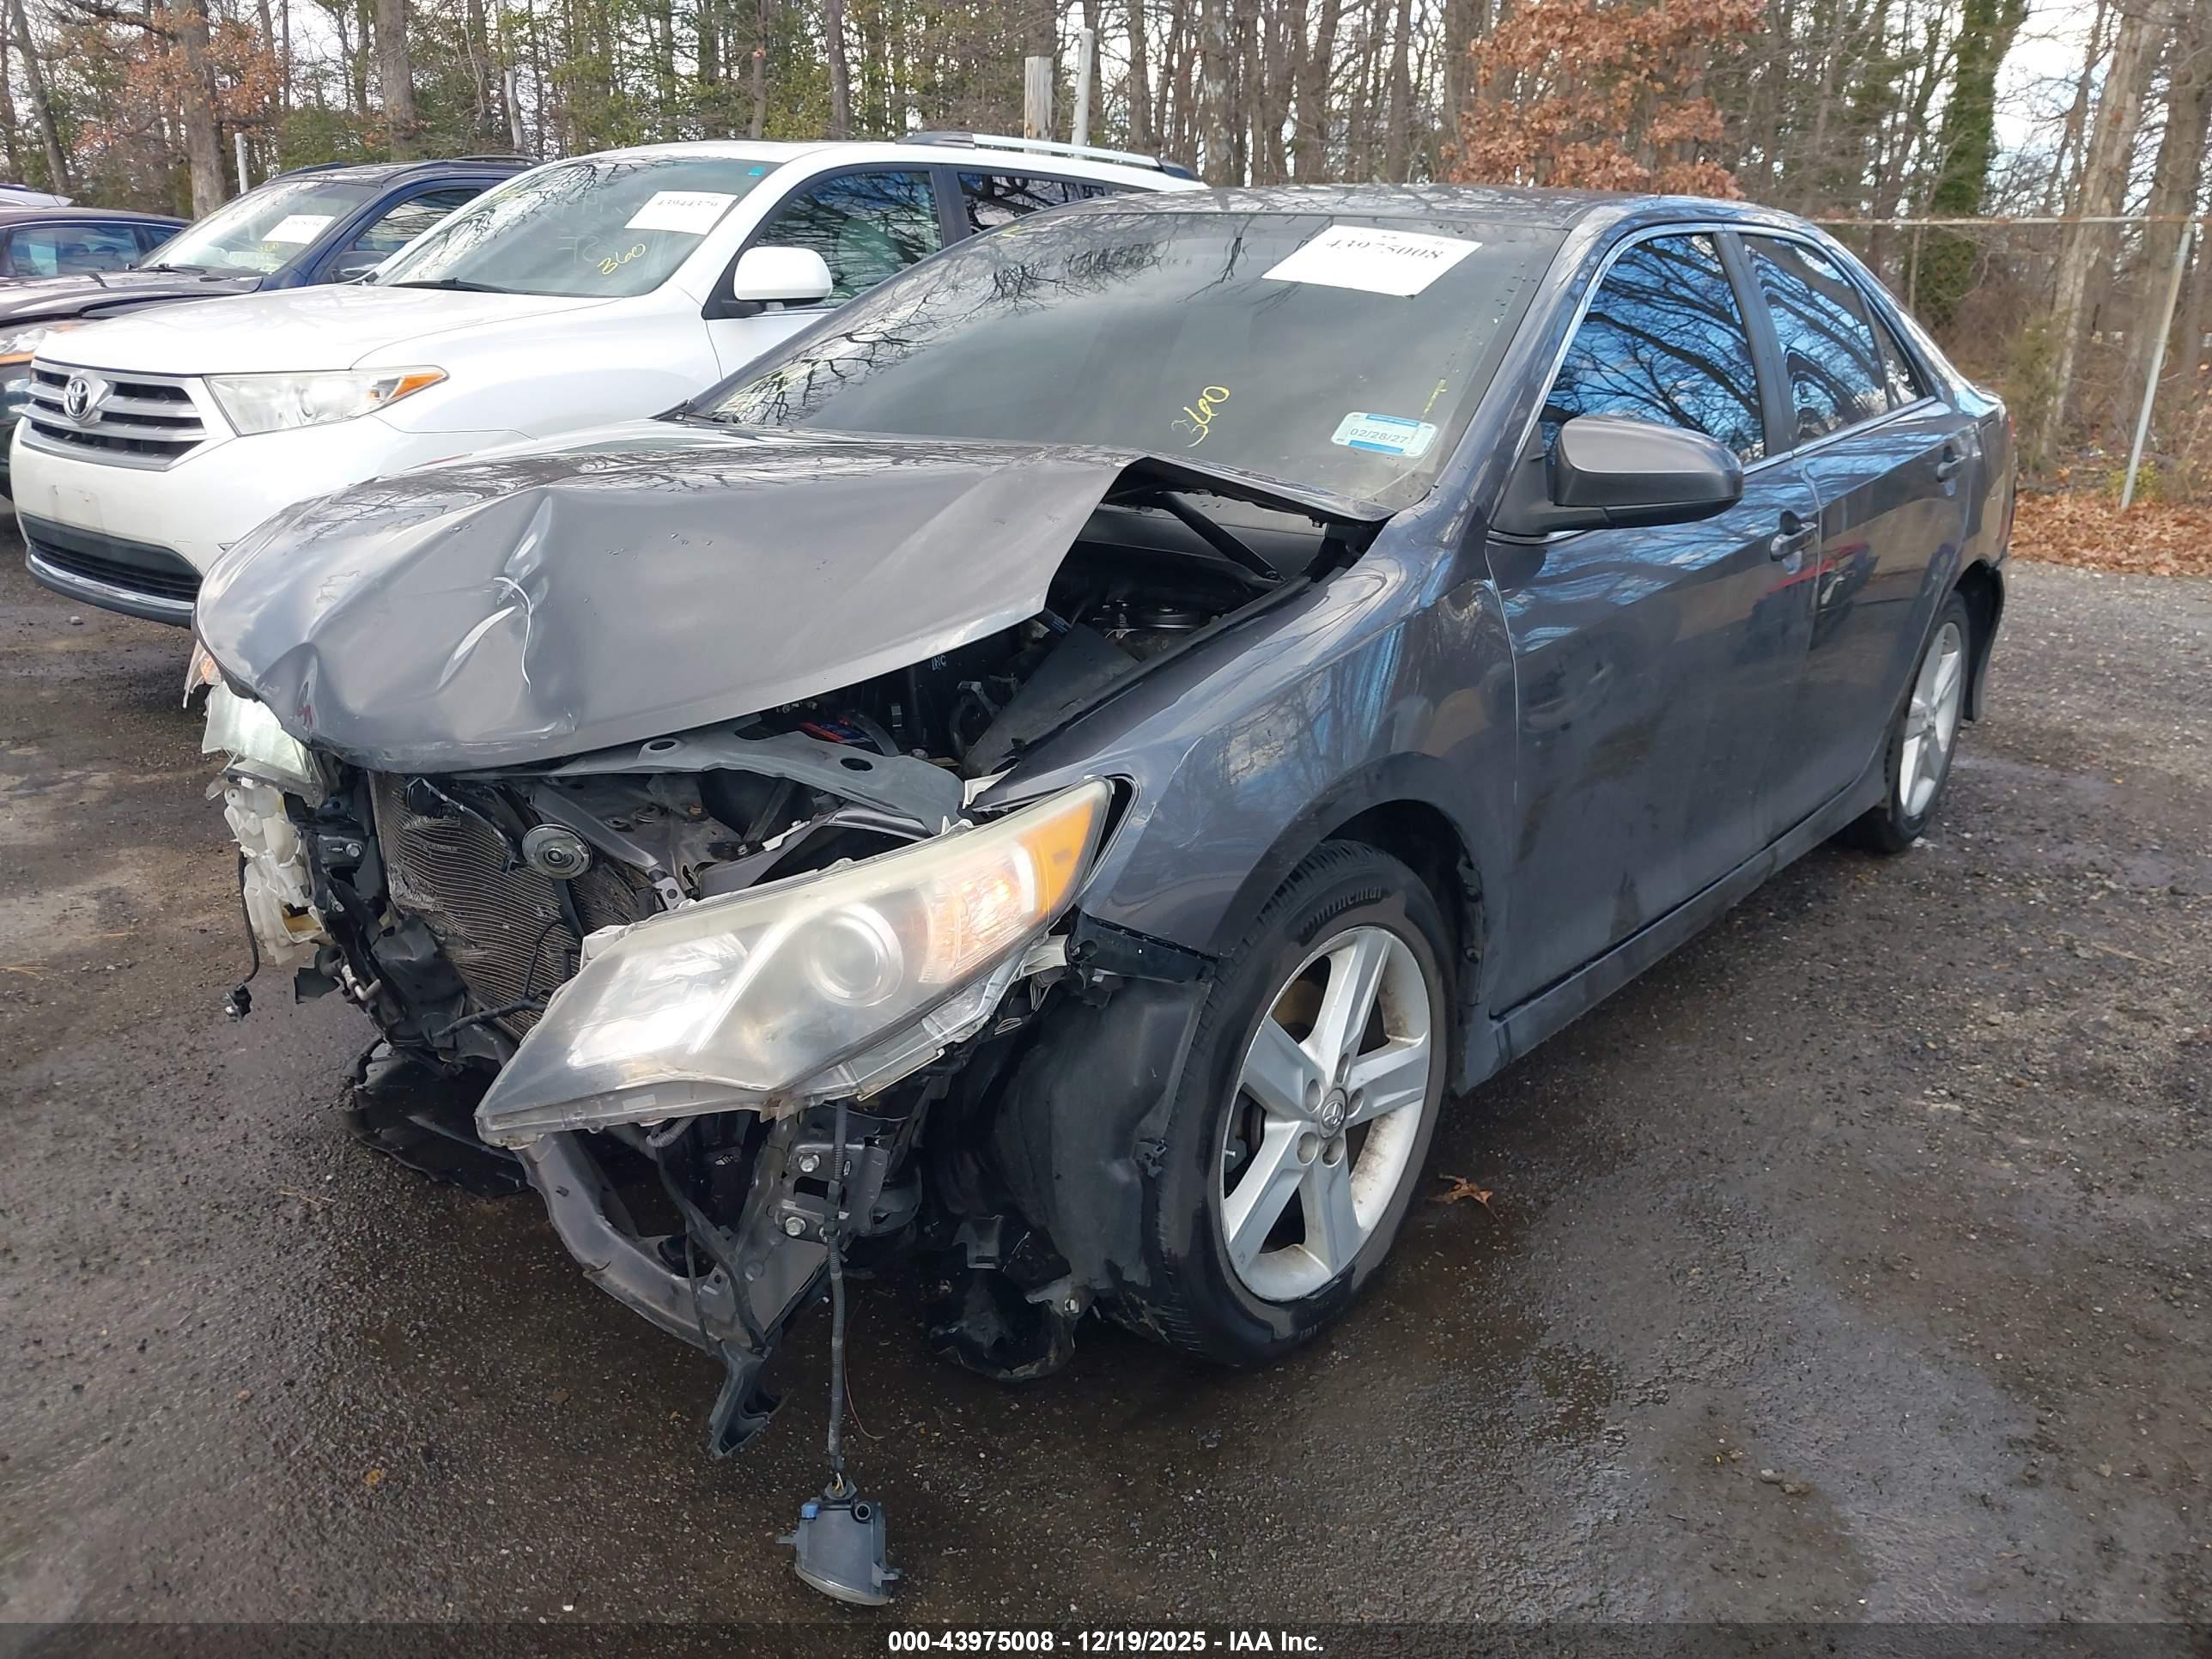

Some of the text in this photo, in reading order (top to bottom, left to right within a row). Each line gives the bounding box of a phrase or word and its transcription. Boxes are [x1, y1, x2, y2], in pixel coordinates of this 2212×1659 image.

[597, 243, 647, 276] 360
[1171, 385, 1230, 447] 360
[1349, 428, 1409, 444] 02/28/27
